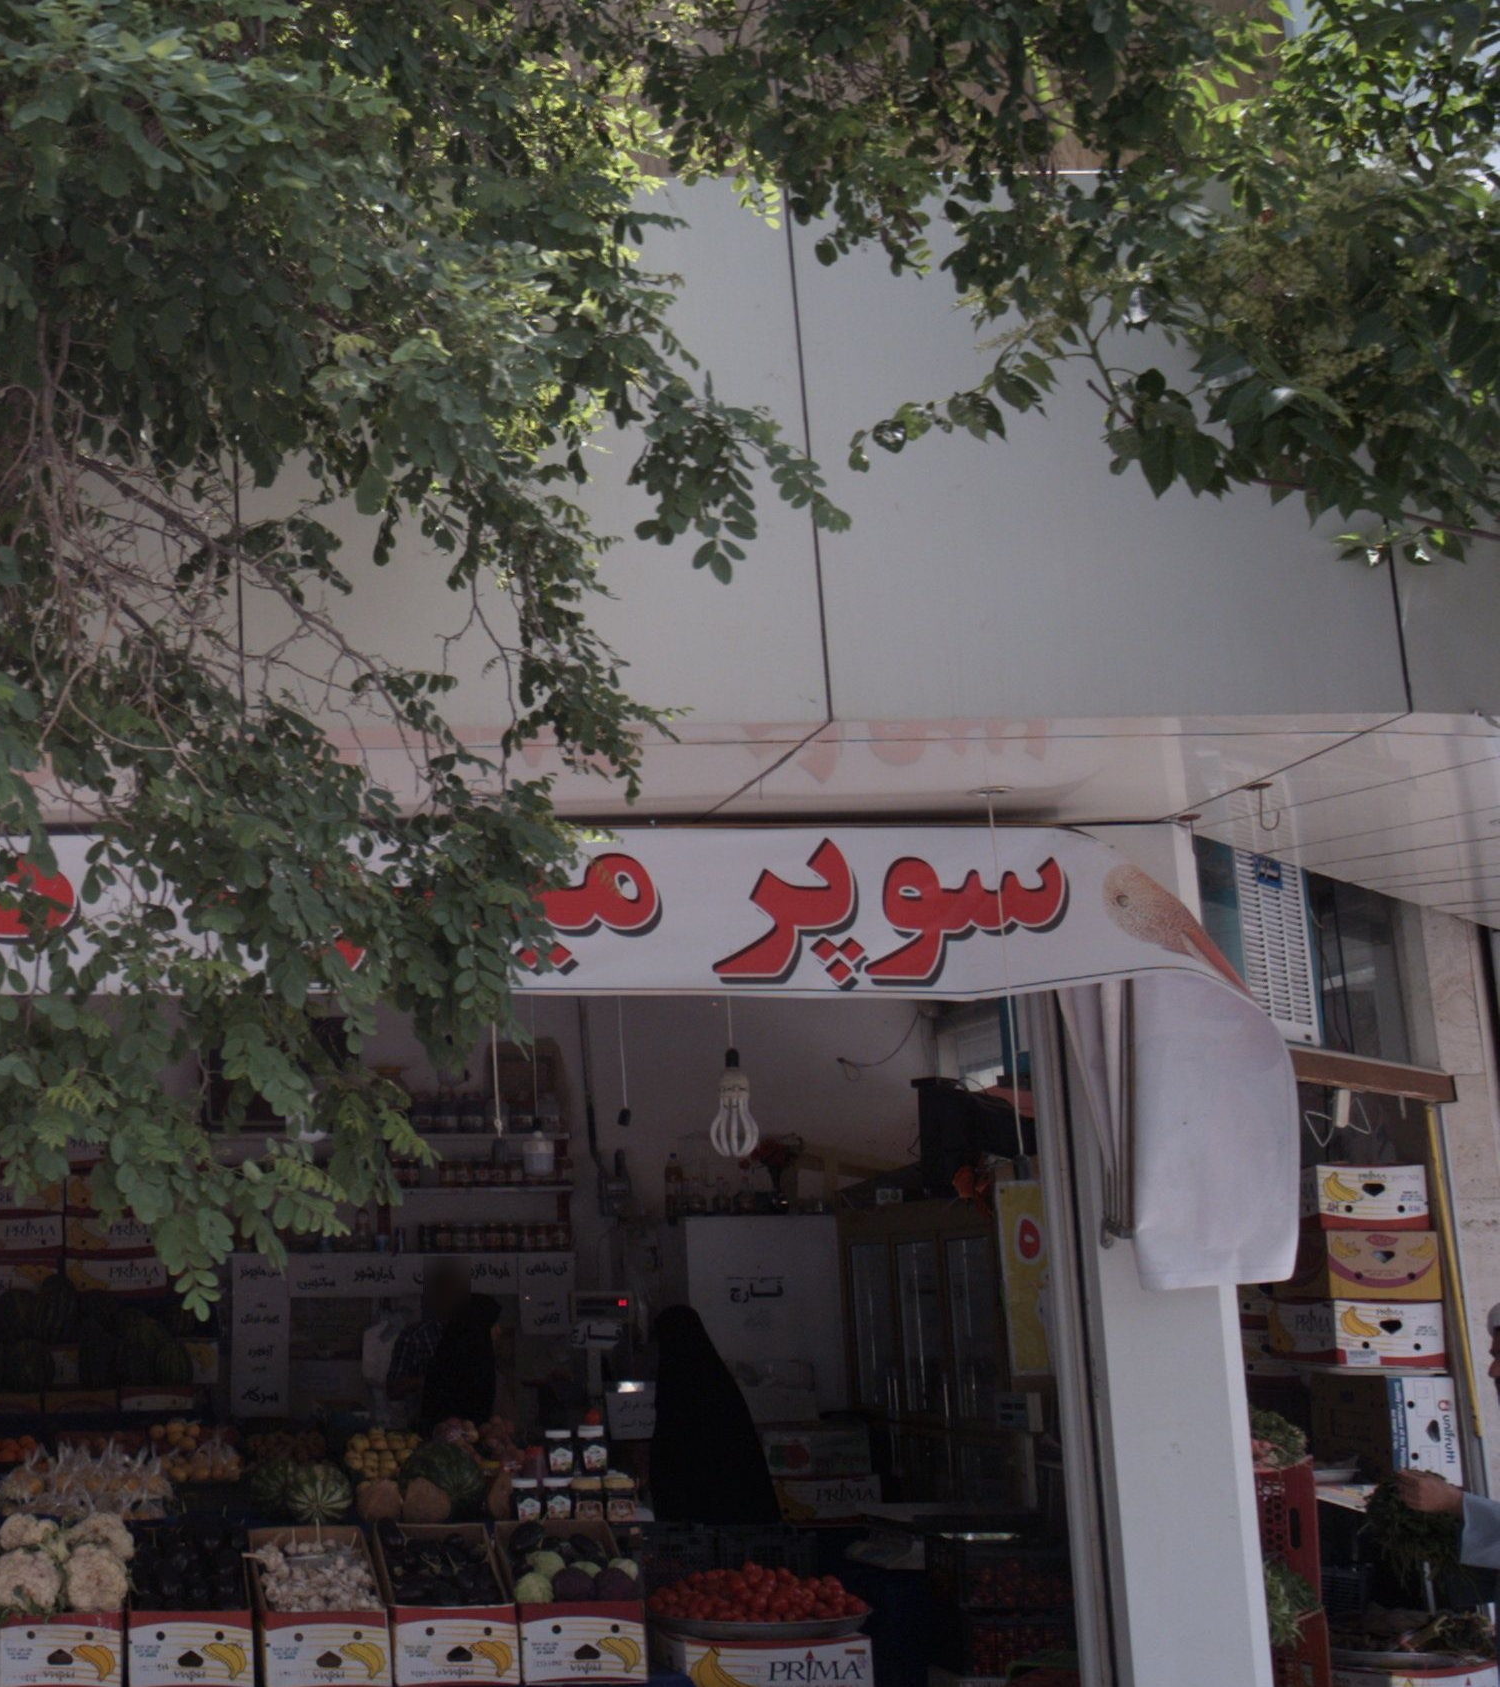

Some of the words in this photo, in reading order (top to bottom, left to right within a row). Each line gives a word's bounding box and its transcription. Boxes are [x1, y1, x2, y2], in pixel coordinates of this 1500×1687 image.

[712, 837, 1068, 988] سوپر
[4, 1220, 55, 1239] PRIMA
[108, 1219, 147, 1238] PRIM
[108, 1262, 159, 1280] PRIMA
[241, 1387, 279, 1405] سرکه
[1442, 1414, 1456, 1464] unifrutti
[816, 1483, 875, 1502] PRIMA
[768, 1659, 864, 1684] PRIMA
